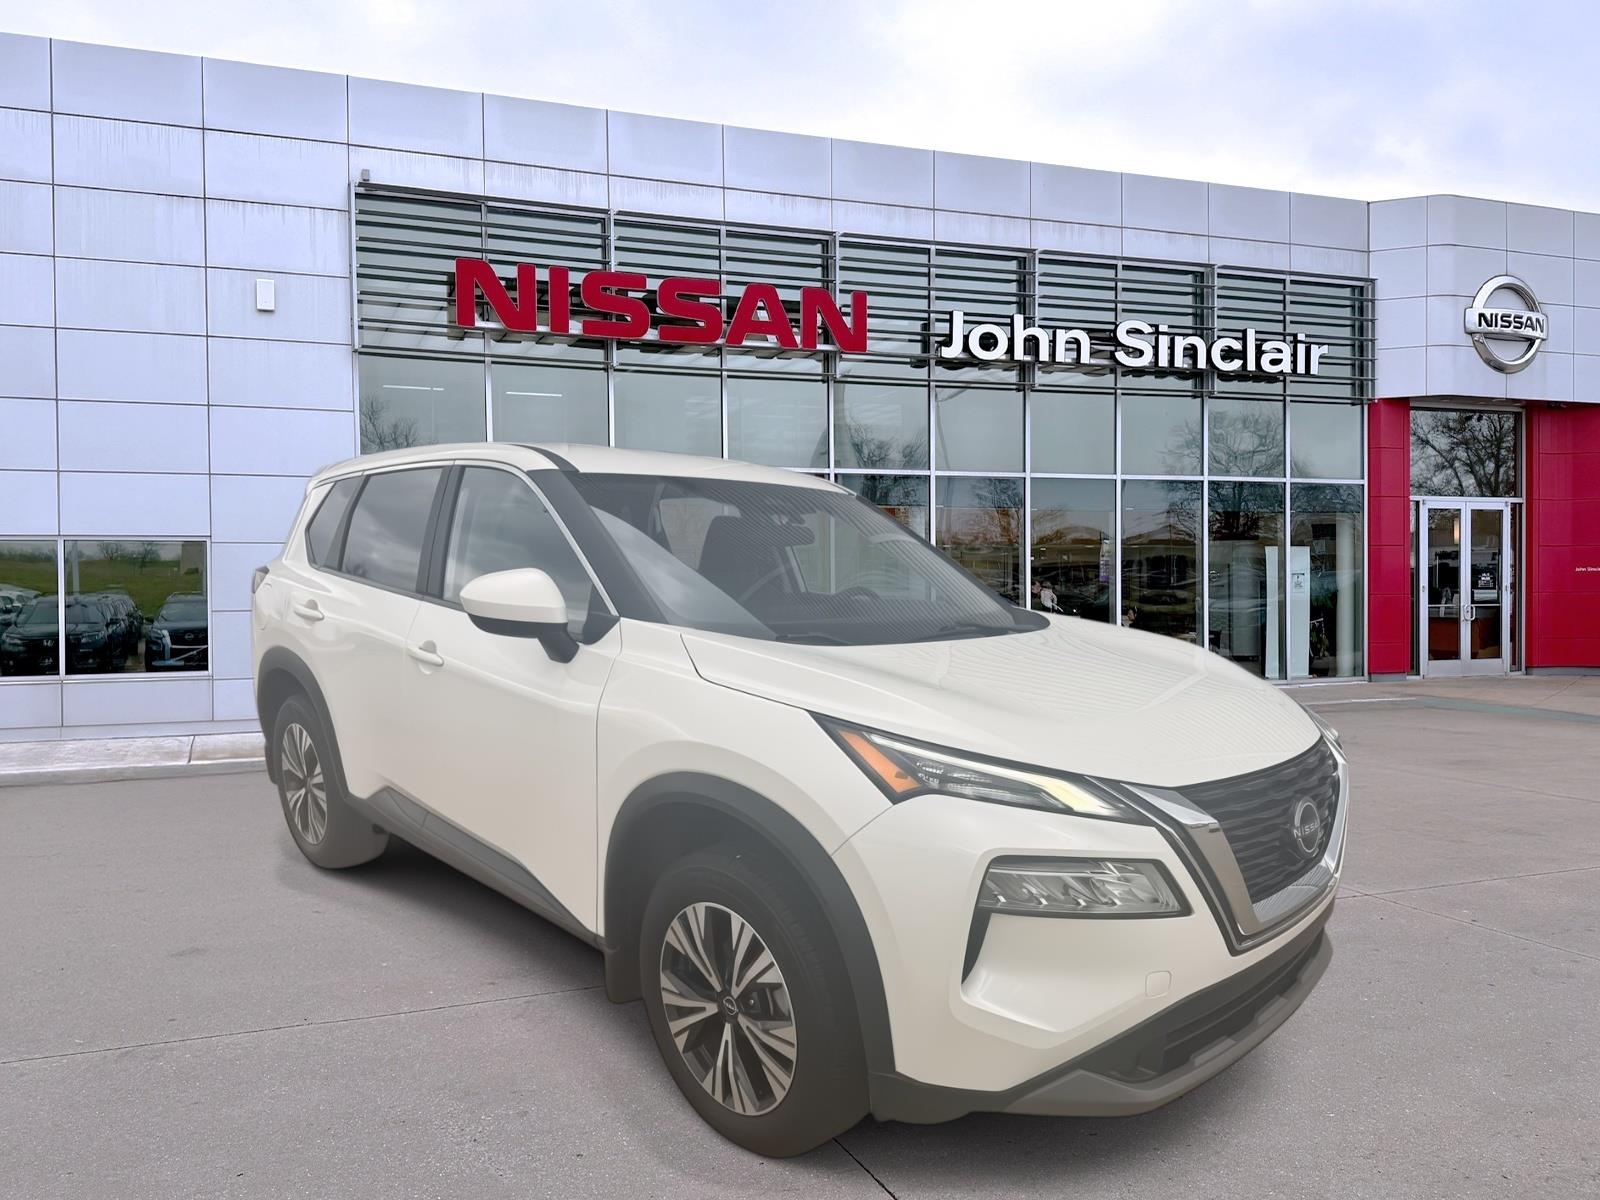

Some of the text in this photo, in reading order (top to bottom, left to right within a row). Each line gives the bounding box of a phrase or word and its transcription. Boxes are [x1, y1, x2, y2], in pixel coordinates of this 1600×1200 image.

[455, 257, 868, 353] NISSAN
[1478, 312, 1545, 333] NISSAN
[941, 310, 1329, 375] John Sinclair
